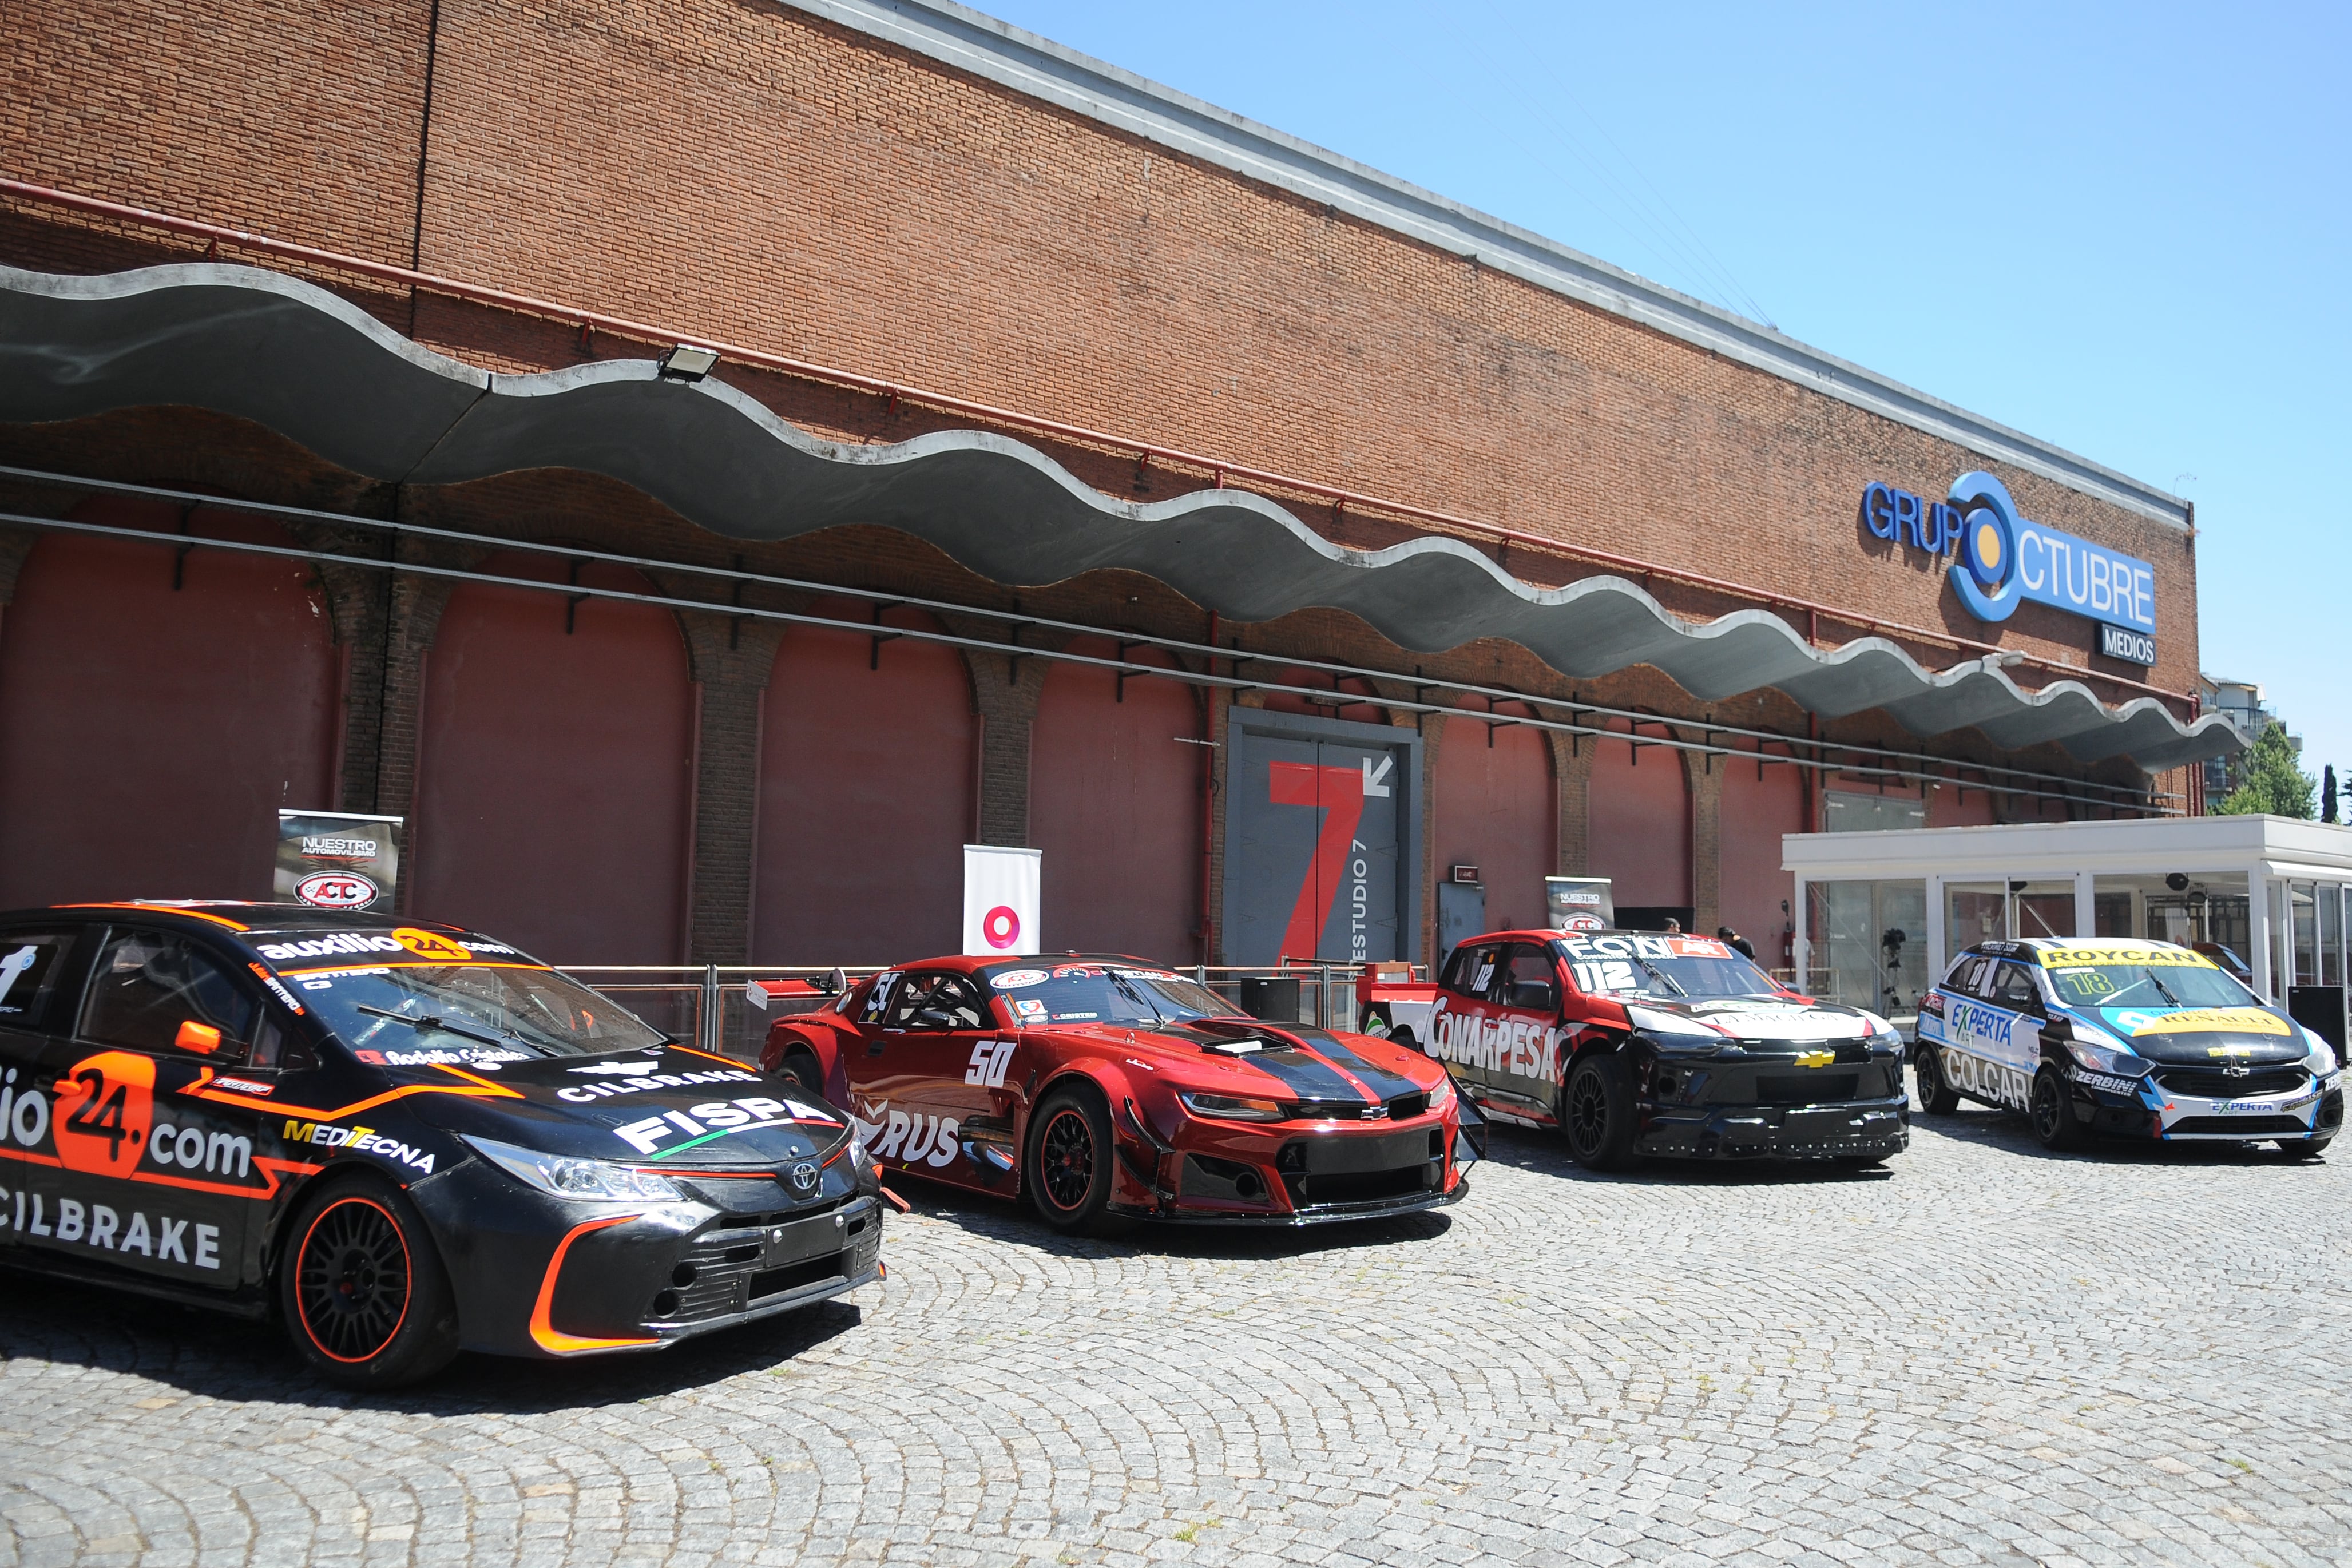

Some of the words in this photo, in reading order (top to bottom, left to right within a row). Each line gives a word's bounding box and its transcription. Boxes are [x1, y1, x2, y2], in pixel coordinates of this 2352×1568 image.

[2104, 628, 2155, 664] MEDIOS
[302, 837, 376, 851] NUESTRO
[302, 847, 376, 857] AUTOMOVILISMO
[1352, 839, 1367, 852] 7
[1268, 760, 1364, 993] 7
[312, 881, 358, 899] ACTC
[1560, 892, 1600, 901] NUESTRO
[1352, 859, 1367, 961] ESTUDIO
[1560, 937, 1675, 956] FON
[2047, 951, 2198, 963] ROYCAN
[1472, 963, 1495, 992] 112
[1572, 961, 1637, 992] 112
[1968, 962, 1987, 986] 18
[2066, 972, 2115, 995] 18
[1952, 1003, 2012, 1047] EXPERTA
[2160, 1015, 2274, 1025] RENAULT
[1423, 996, 1557, 1083] CONARPESA
[965, 1040, 1017, 1087] 50
[557, 1070, 763, 1102] CILBRAKE
[1946, 1049, 2030, 1114] COLCAR
[2076, 1070, 2138, 1093] ZERBINI
[2212, 1102, 2273, 1114] EXPERTA
[613, 1098, 838, 1155] FISPA
[283, 1120, 435, 1174] MEDITECNA
